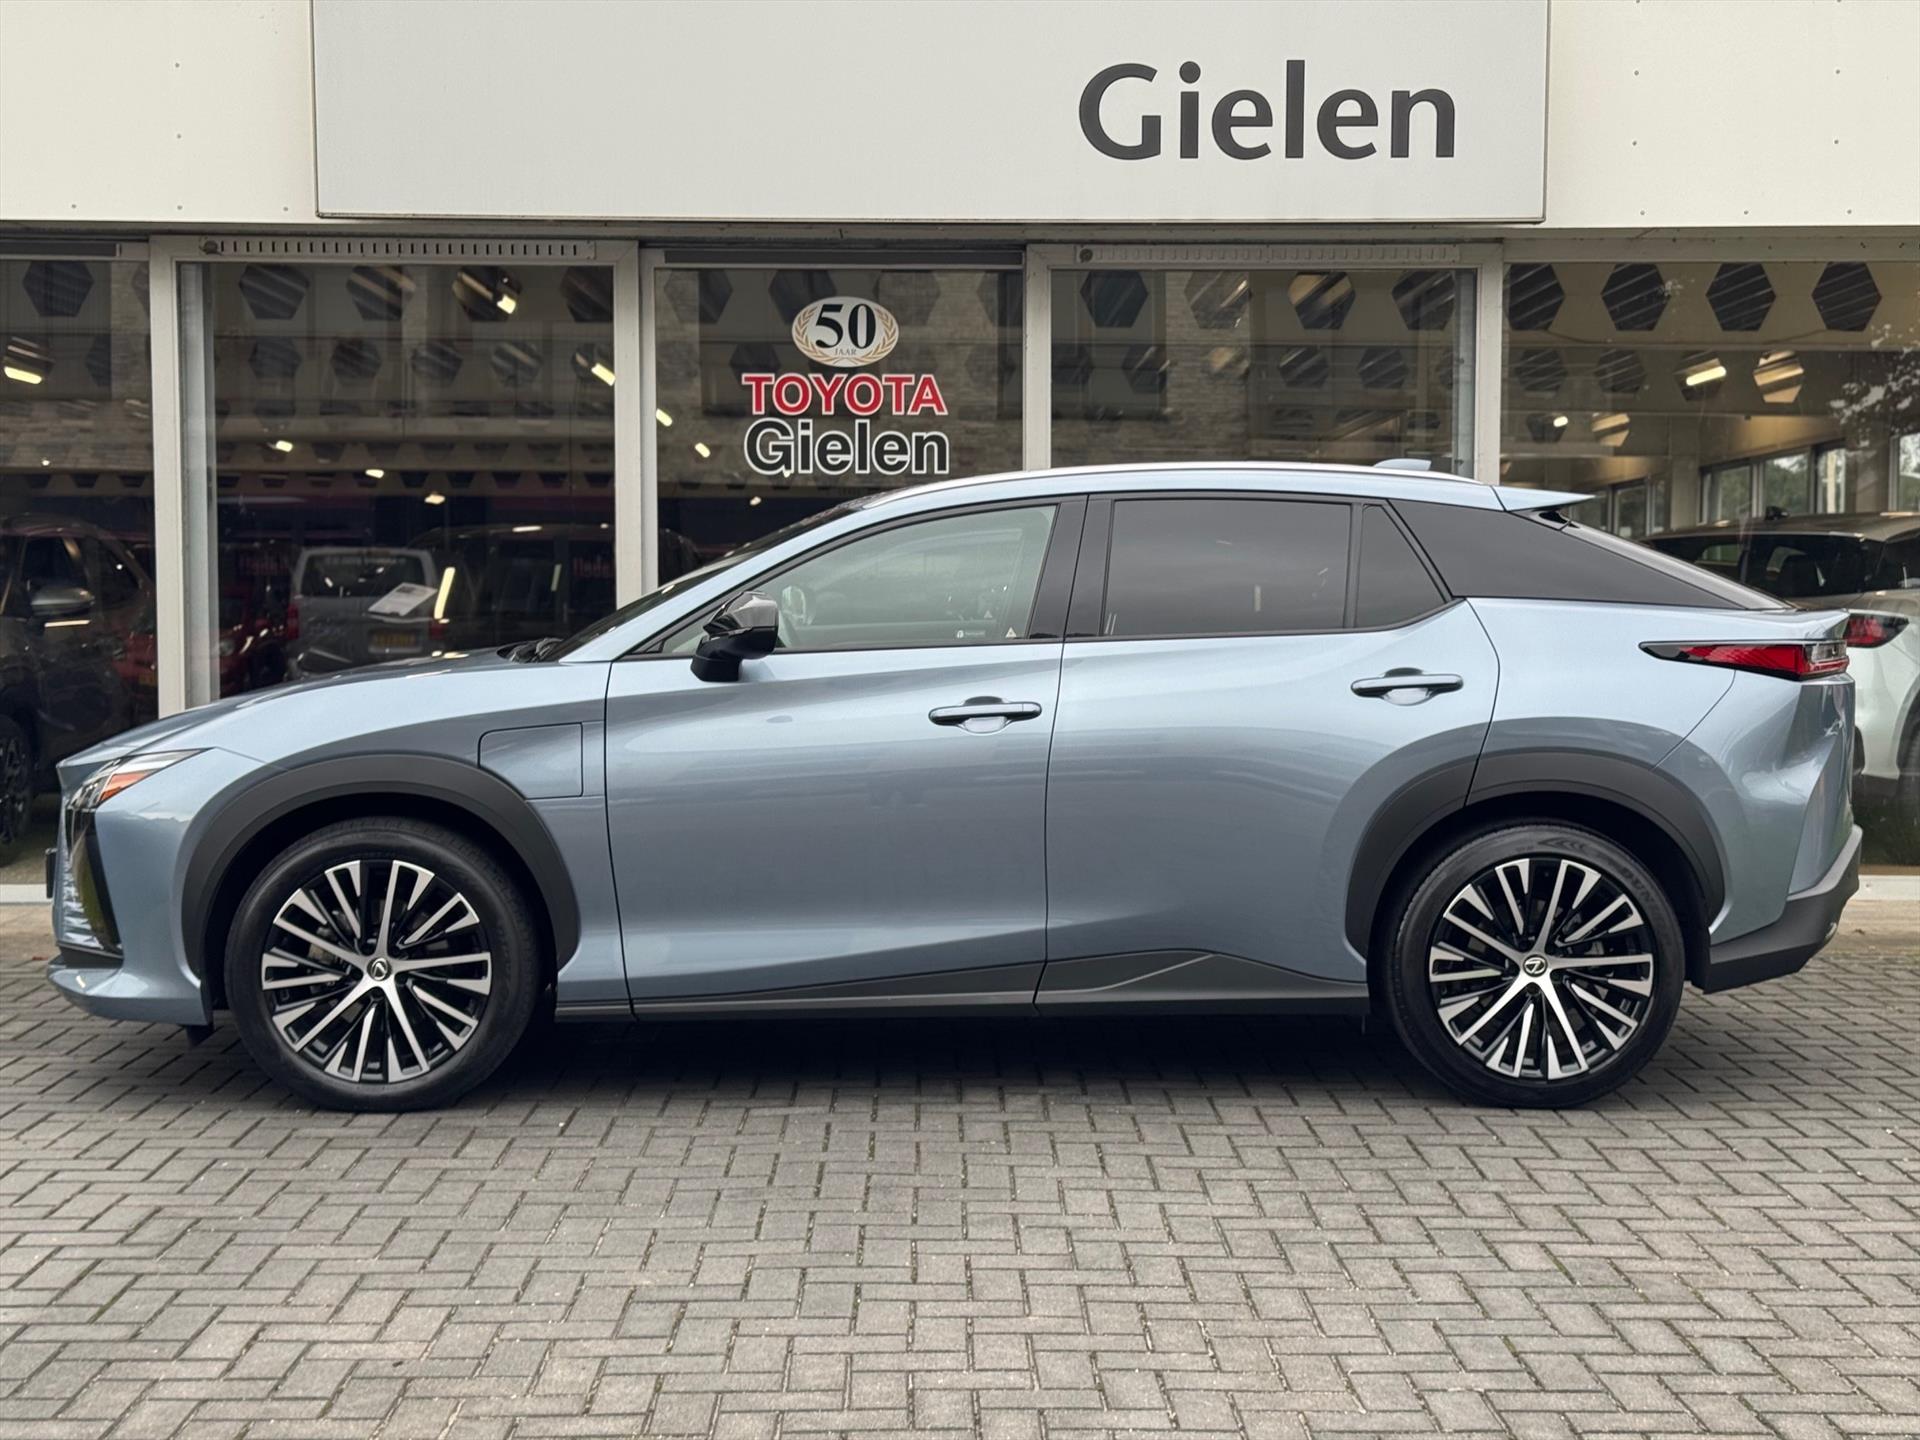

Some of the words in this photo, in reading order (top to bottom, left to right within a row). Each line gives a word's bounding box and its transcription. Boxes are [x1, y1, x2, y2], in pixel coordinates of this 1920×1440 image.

[1078, 59, 1456, 161] Gielen
[814, 303, 877, 350] 50
[742, 373, 949, 416] TOYOTA
[744, 417, 950, 476] Gielen
